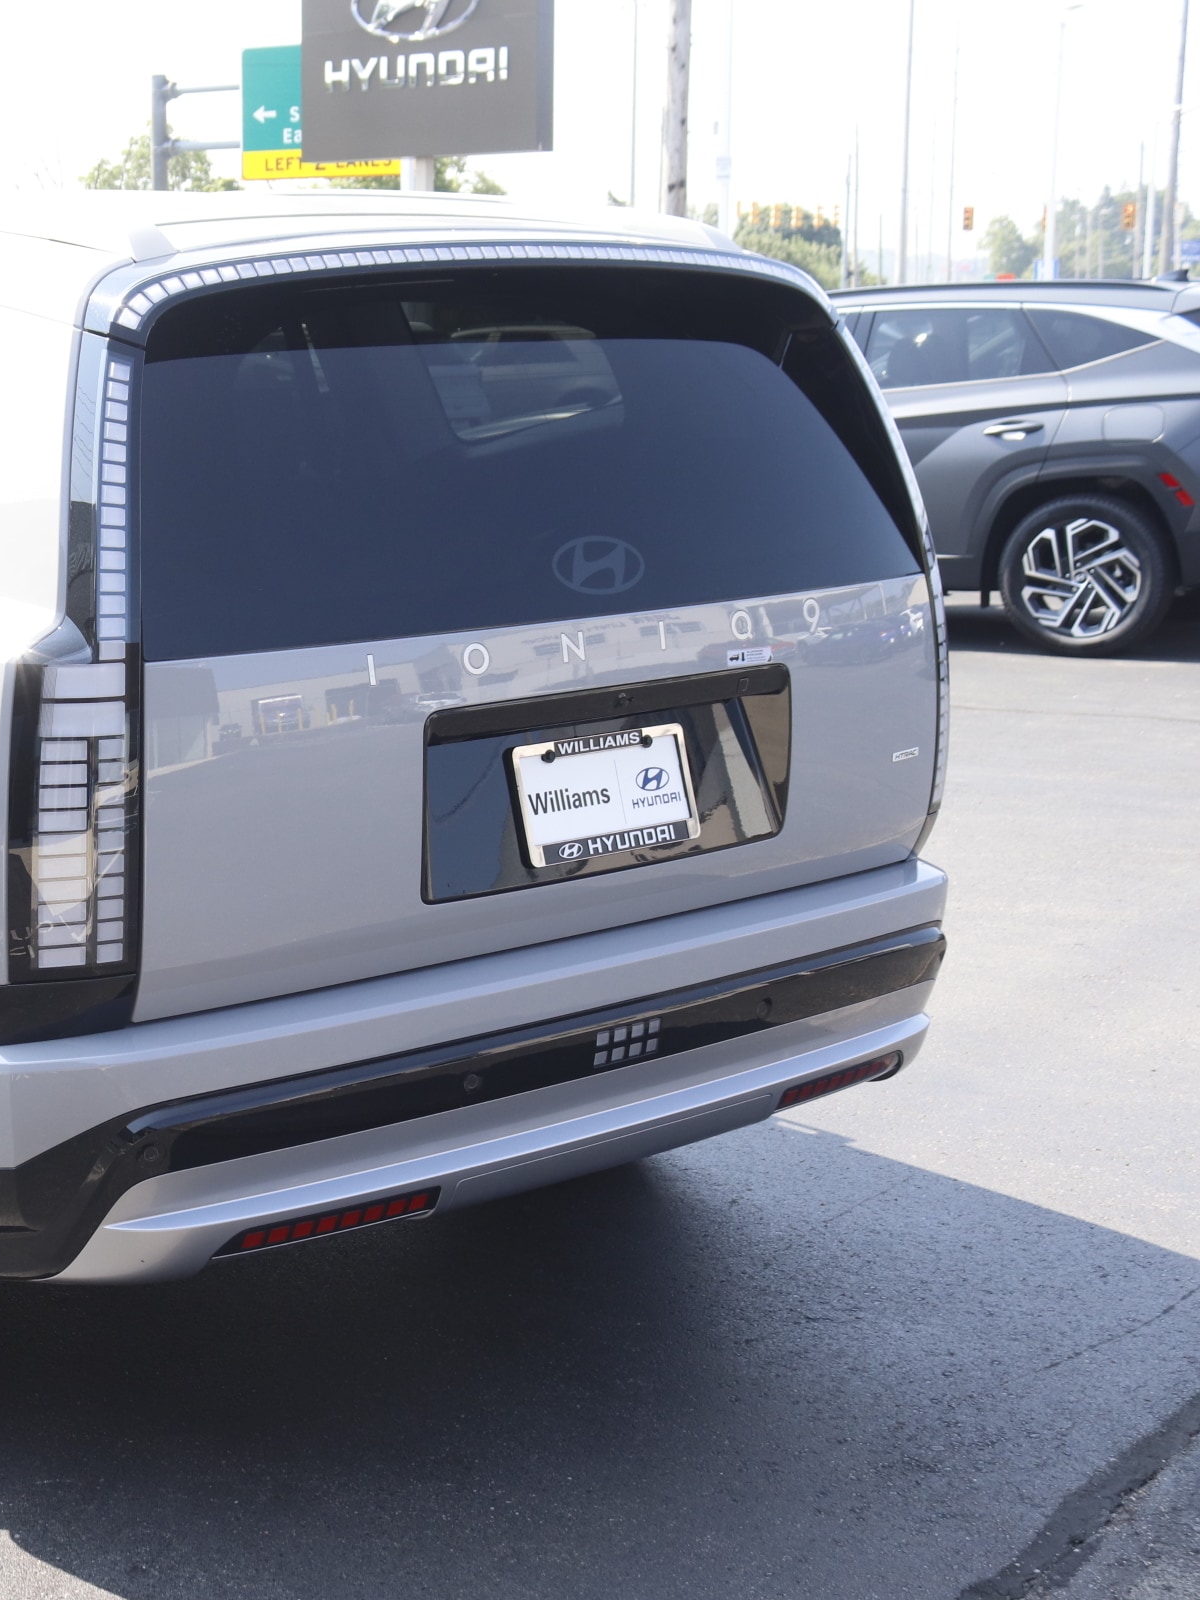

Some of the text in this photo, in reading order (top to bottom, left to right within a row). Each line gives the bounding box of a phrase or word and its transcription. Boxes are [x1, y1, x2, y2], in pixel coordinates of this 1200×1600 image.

[324, 46, 508, 91] HYUNDAI
[265, 157, 302, 171] LEFT
[558, 732, 640, 755] WILLIAMS
[528, 787, 611, 815] Williams
[632, 791, 681, 810] HYUNDAI
[588, 825, 673, 855] HYUNDAI
